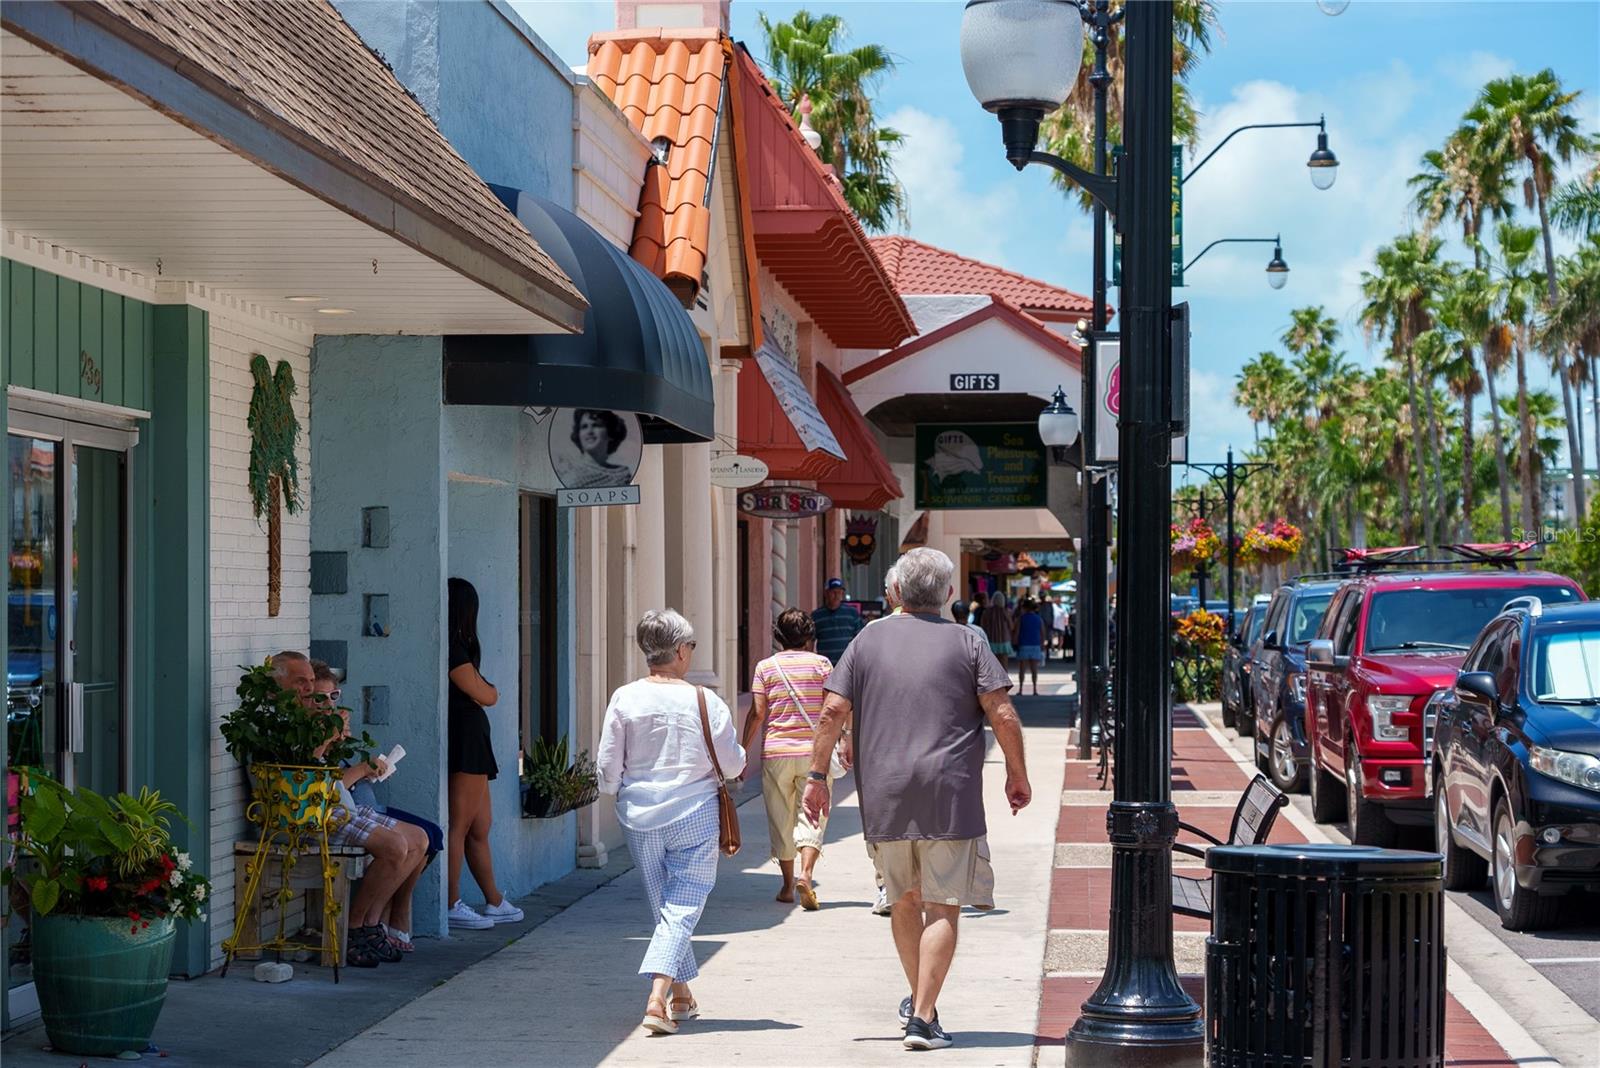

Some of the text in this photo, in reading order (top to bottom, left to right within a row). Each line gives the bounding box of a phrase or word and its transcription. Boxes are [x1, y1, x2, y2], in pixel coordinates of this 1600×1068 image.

[81, 350, 101, 394] 239
[954, 375, 996, 390] GIFTS
[938, 434, 964, 445] GIFTS
[1003, 433, 1025, 446] Sea
[1004, 459, 1024, 472] and
[566, 489, 628, 504] SOAPS
